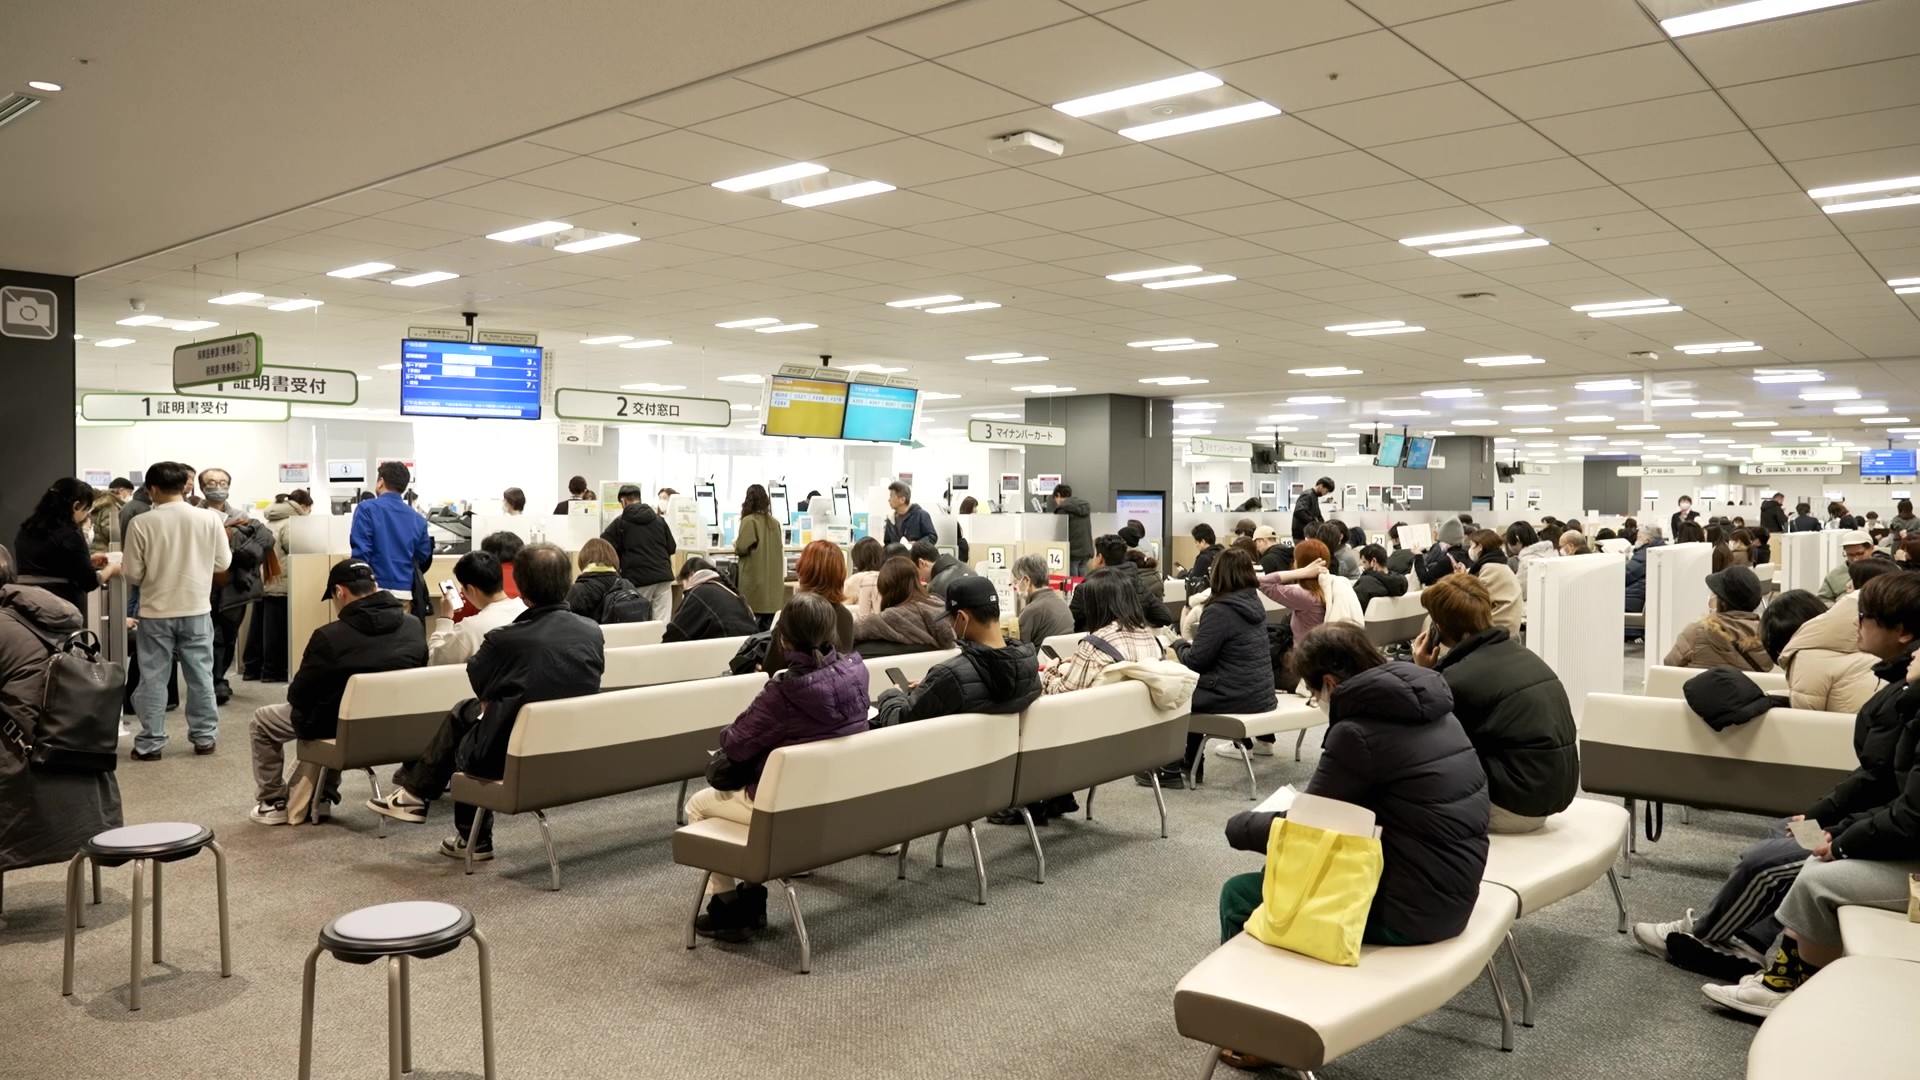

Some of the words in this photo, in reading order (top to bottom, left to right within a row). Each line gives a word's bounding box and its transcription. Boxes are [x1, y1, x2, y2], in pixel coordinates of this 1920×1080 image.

[233, 375, 326, 394] 証明書受付
[141, 397, 151, 416] 1
[157, 401, 228, 414] 証明書受付
[617, 396, 628, 417] 2
[633, 402, 680, 417] 交付窓口
[985, 423, 992, 440] 3
[996, 428, 1053, 441] マイナンバーカード
[1199, 440, 1204, 453] 3
[1293, 447, 1298, 457] 4
[1643, 467, 1649, 475] 5
[1755, 465, 1762, 474] 6
[1375, 537, 1383, 545] 21
[991, 552, 1002, 564] 13
[1050, 553, 1061, 565] 14
